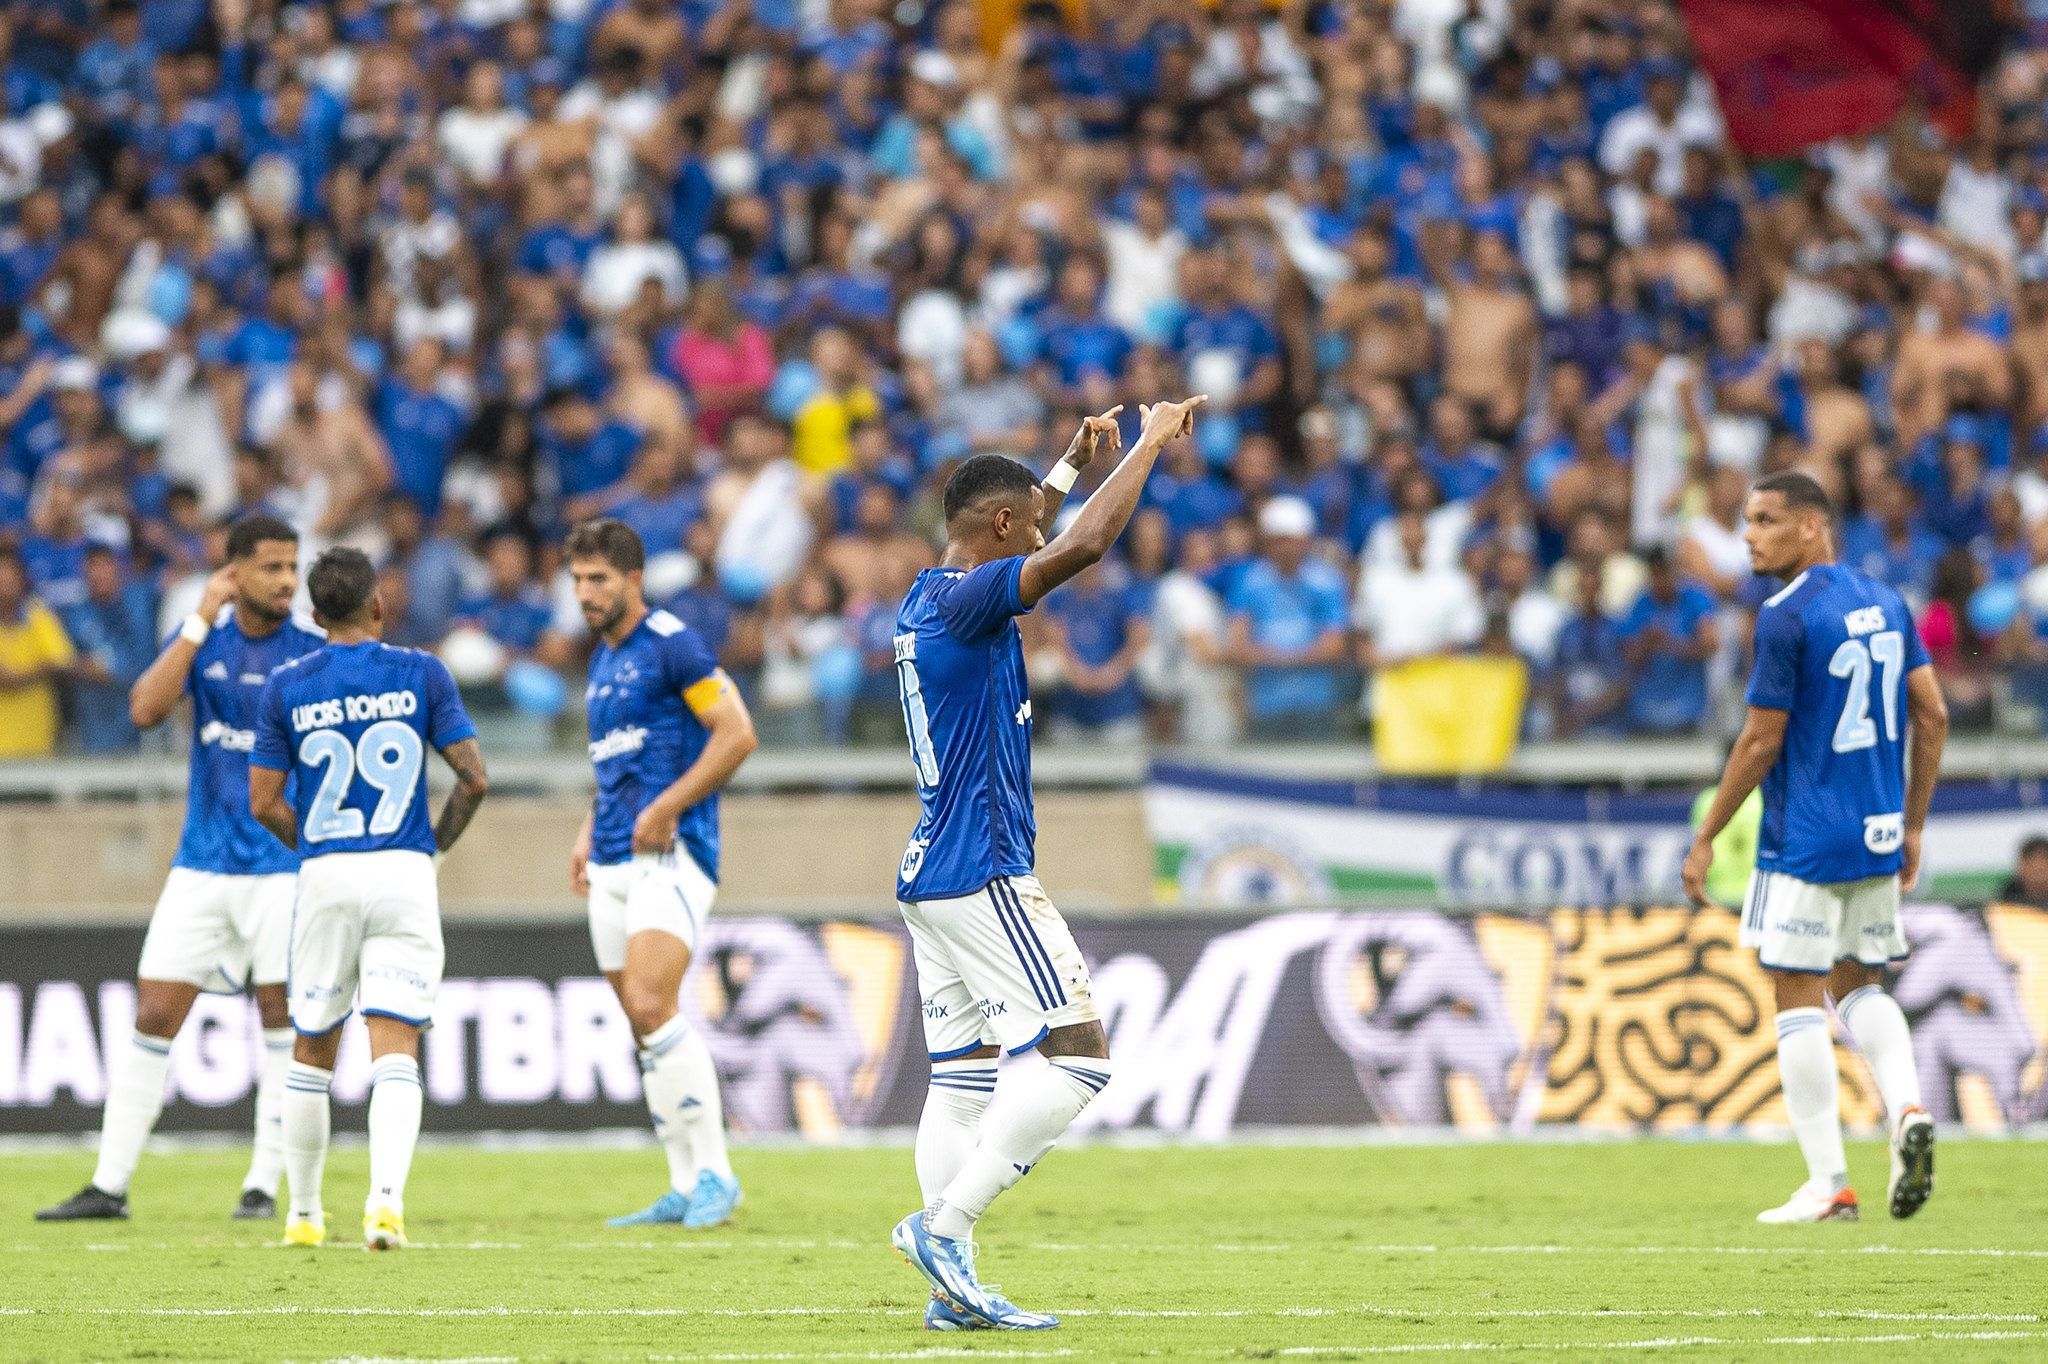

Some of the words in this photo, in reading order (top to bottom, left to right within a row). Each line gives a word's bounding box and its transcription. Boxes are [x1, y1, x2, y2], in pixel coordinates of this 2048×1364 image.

[292, 698, 345, 733] LUCAS
[344, 690, 418, 722] ROMERO
[1828, 630, 1904, 754] 27
[299, 719, 424, 844] 29
